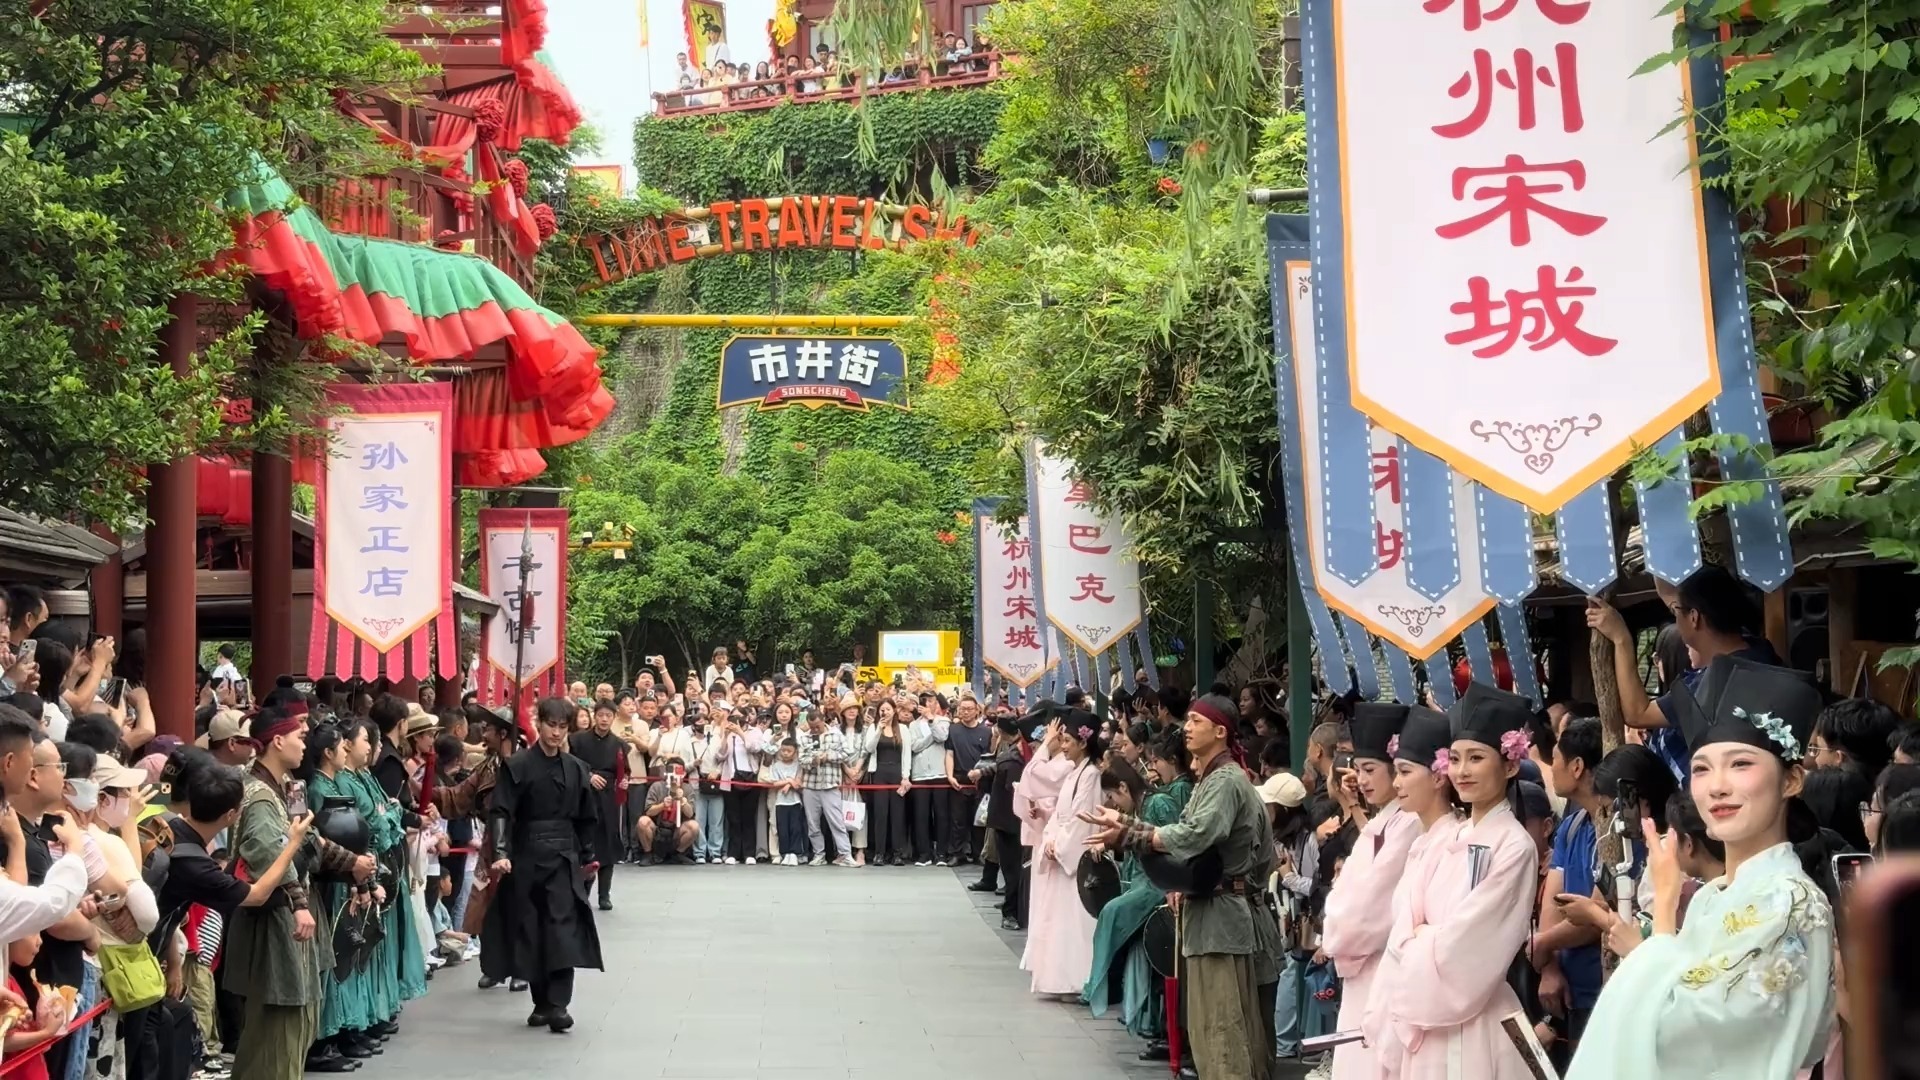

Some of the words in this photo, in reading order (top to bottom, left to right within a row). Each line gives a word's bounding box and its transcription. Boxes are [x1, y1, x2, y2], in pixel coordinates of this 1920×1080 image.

[581, 211, 697, 283] TIME
[709, 194, 885, 253] TRAVEL
[748, 340, 880, 387] 市井街
[781, 386, 847, 397] SONGCHENG
[358, 441, 409, 598] 孙家正店
[1002, 537, 1042, 650] 杭州宋城
